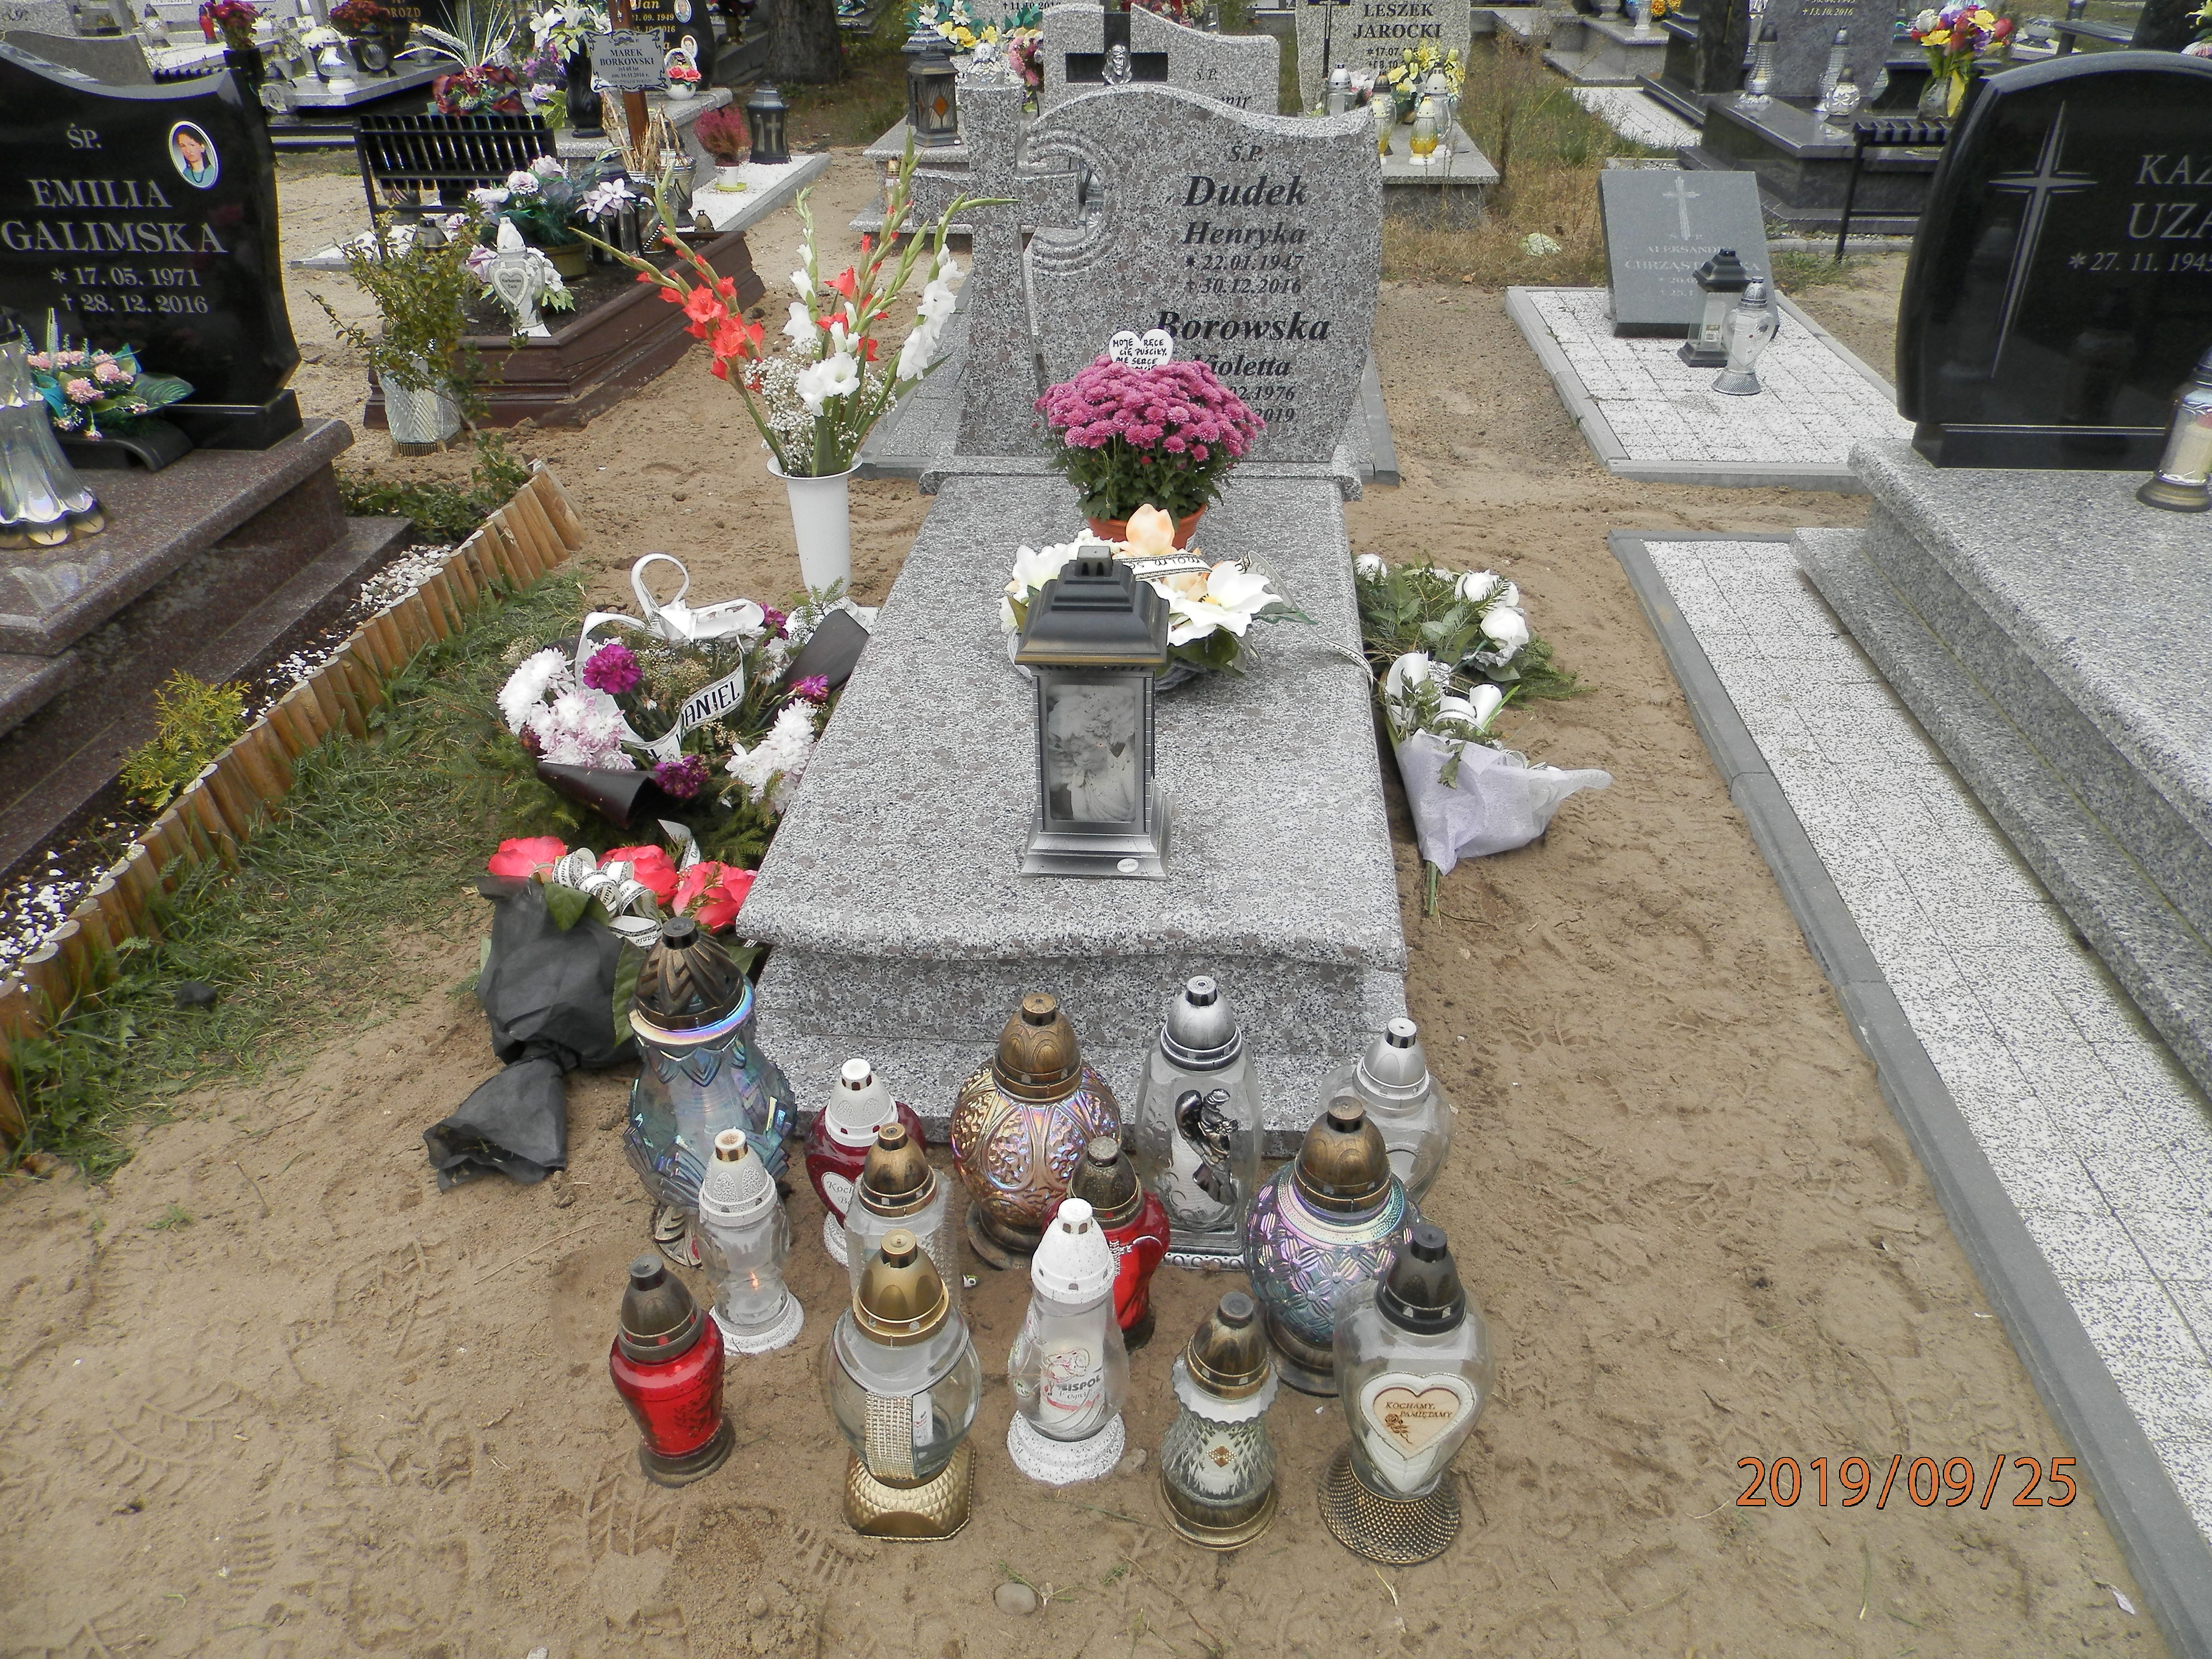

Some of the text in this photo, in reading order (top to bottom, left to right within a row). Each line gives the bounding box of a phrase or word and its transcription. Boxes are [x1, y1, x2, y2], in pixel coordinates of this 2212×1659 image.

[1363, 4, 1433, 16] LESZEK
[1810, 8, 1854, 16] 13.10.2016
[1353, 24, 1440, 38] JAROCKI
[600, 58, 654, 66] BORKOWSKI
[67, 123, 101, 148] ŚP.
[28, 179, 173, 208] EMILIA
[1182, 175, 1307, 206] Dudek
[1, 220, 228, 253] GALIMSKA
[1182, 221, 1305, 250] Henryka
[1201, 254, 1304, 272] 22.01.1947
[1201, 278, 1302, 295] 30.12.2016
[1157, 311, 1331, 341] Borowska
[1113, 338, 1133, 350] MOJE
[682, 681, 740, 726] ANIEL
[1060, 1374, 1100, 1391] BISPOL
[1386, 1402, 1435, 1410] KOCHAMY,
